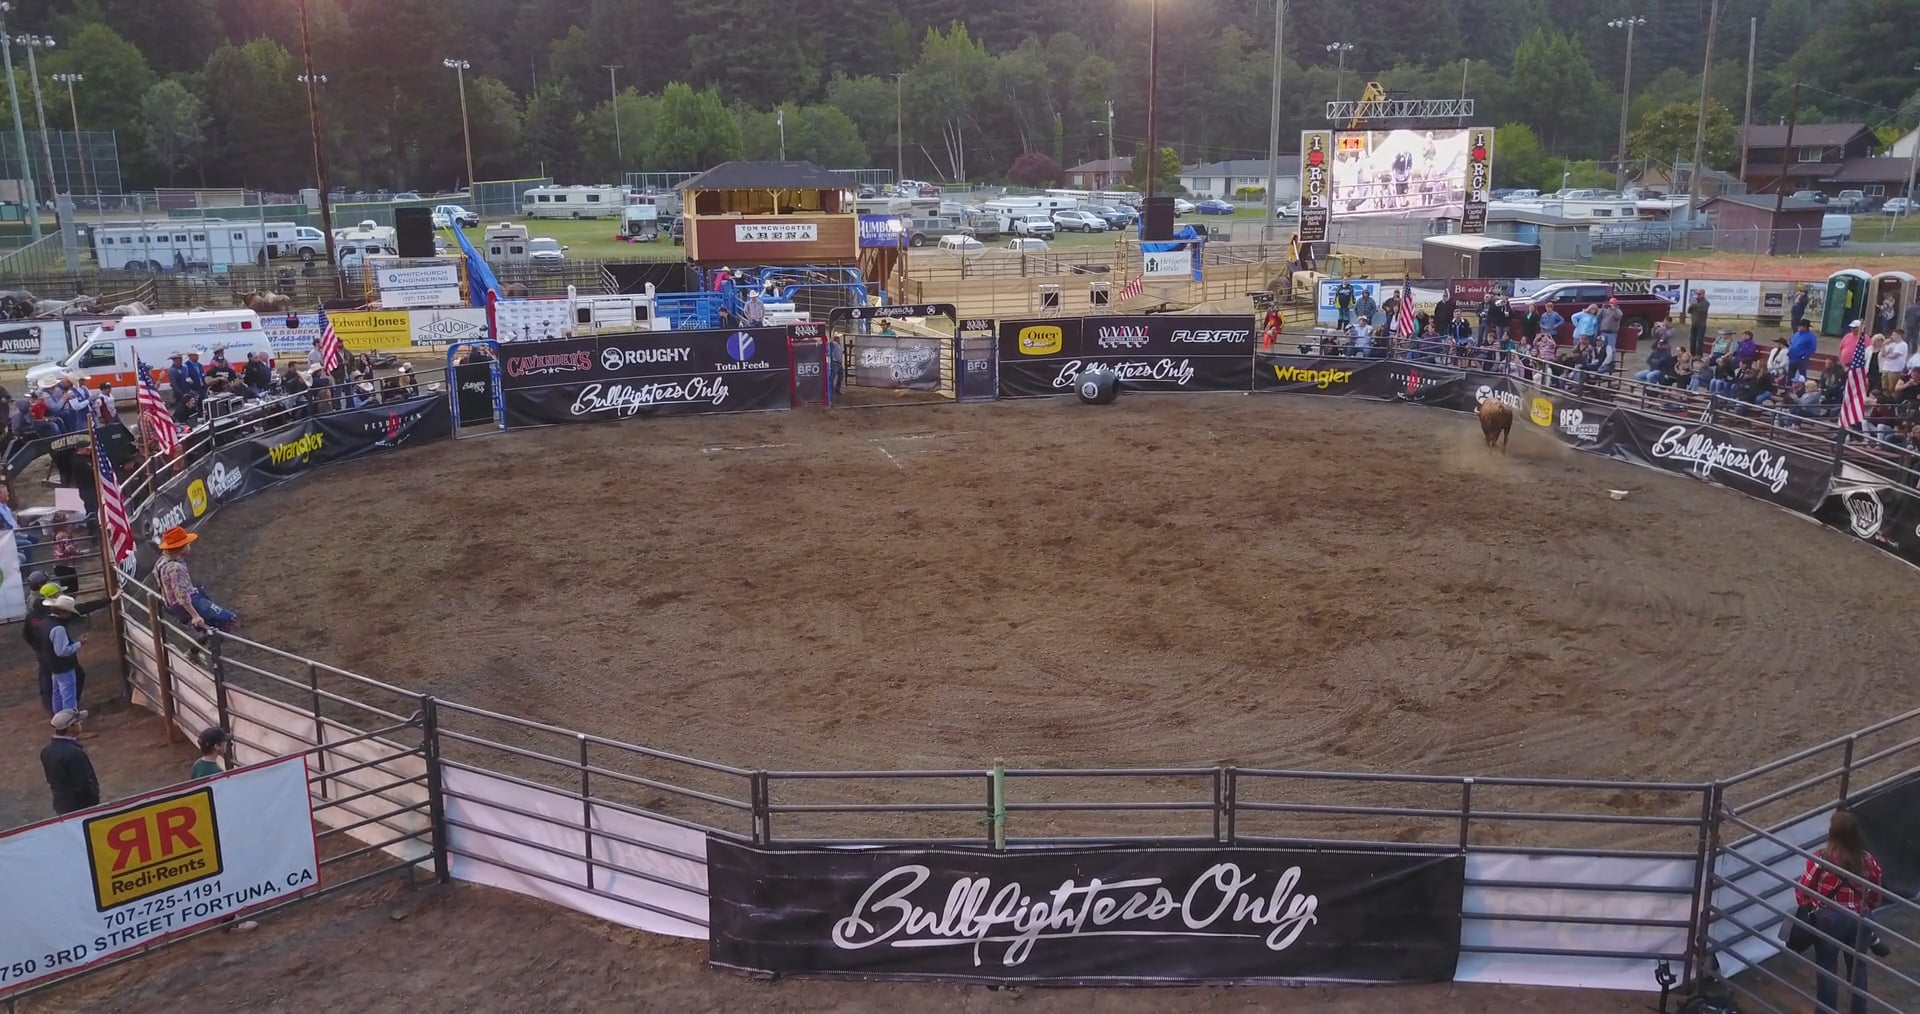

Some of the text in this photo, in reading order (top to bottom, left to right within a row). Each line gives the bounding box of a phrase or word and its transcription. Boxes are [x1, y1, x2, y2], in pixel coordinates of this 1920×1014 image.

[742, 231, 811, 240] ARENA
[398, 275, 449, 283] ENGINEERING
[332, 317, 372, 327] Edward
[373, 316, 406, 327] Jones
[429, 321, 469, 333] SEQUOIA
[0, 338, 40, 351] AYROOM
[344, 336, 401, 345] NVESTMENTS
[1171, 330, 1249, 343] FLEXFIT
[506, 350, 592, 377] CAVENDER'S
[625, 347, 691, 365] ROUGHY
[715, 360, 770, 371] Total Feeds
[797, 364, 820, 375] BFO
[967, 361, 988, 371] BFO
[1152, 359, 1194, 385] Only
[1274, 364, 1353, 388] Wrangler
[570, 377, 729, 417] Bullfighters Only
[1559, 408, 1583, 427] BFO
[268, 432, 324, 464] Wrangler
[1651, 425, 1789, 493] Bullfighters Only
[103, 880, 223, 930] 707-725-1191
[43, 944, 88, 970] 3RD
[94, 912, 175, 953] STREET
[182, 880, 282, 922] FORTUNA,
[285, 867, 314, 888] CA
[831, 862, 1319, 967] Bullfighters Only
